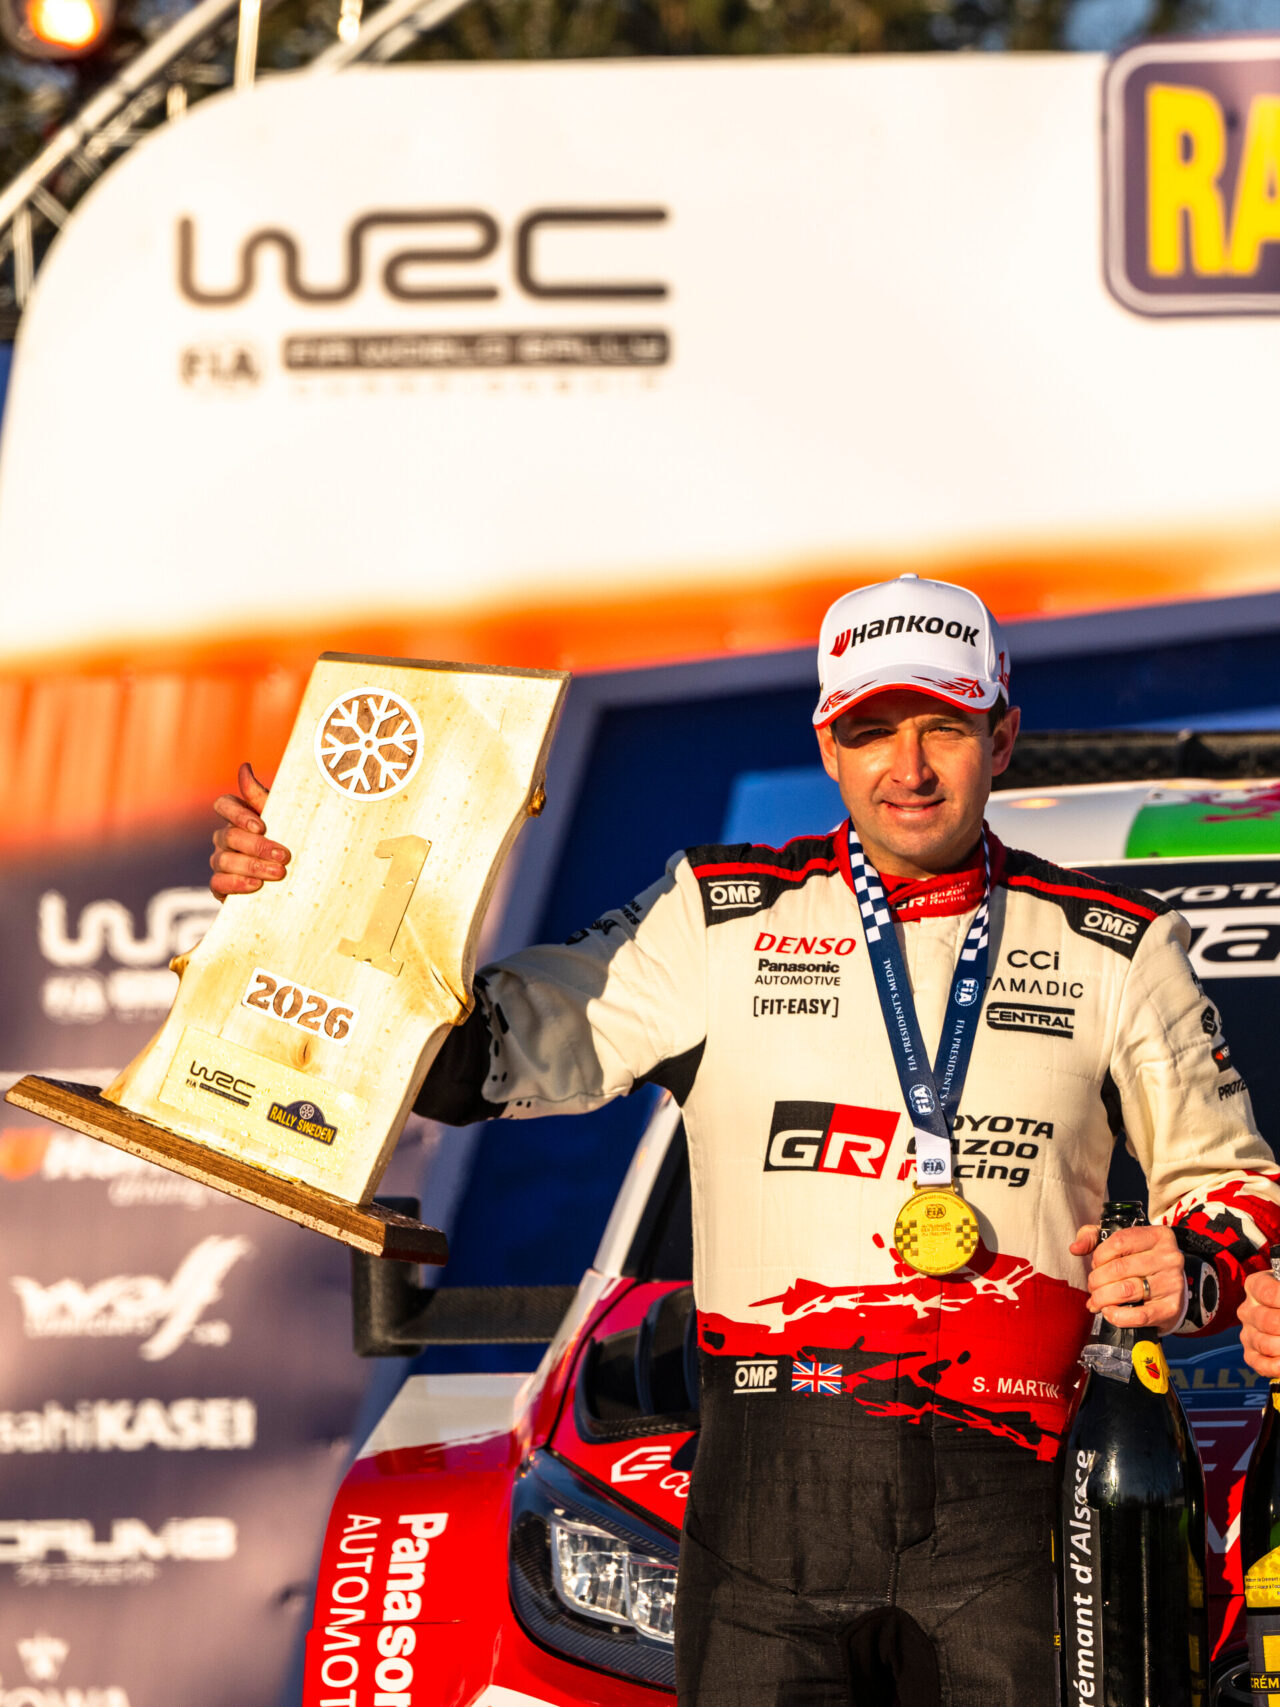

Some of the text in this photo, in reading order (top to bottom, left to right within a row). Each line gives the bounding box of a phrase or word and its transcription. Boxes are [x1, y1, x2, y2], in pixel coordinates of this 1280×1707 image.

[177, 207, 669, 304] WRC
[337, 834, 432, 977] 1
[710, 886, 762, 905] OMP
[1084, 913, 1138, 938] OMP
[754, 932, 857, 956] DENSO
[758, 958, 840, 974] Panasonic
[754, 975, 841, 987] AUTOMOTIVE
[246, 974, 354, 1040] 2026
[883, 958, 918, 1071] FIA PRESIDENT'S MEDAL
[954, 1019, 966, 1035] FIA
[986, 1010, 1074, 1030] CENTRAL
[190, 1060, 256, 1099] WRC
[269, 1105, 336, 1143] RALLY SWEDEN
[768, 1129, 886, 1174] GR
[734, 1365, 777, 1389] OMP
[972, 1376, 1060, 1399] S. MARTIN
[1072, 1592, 1096, 1707] rémant
